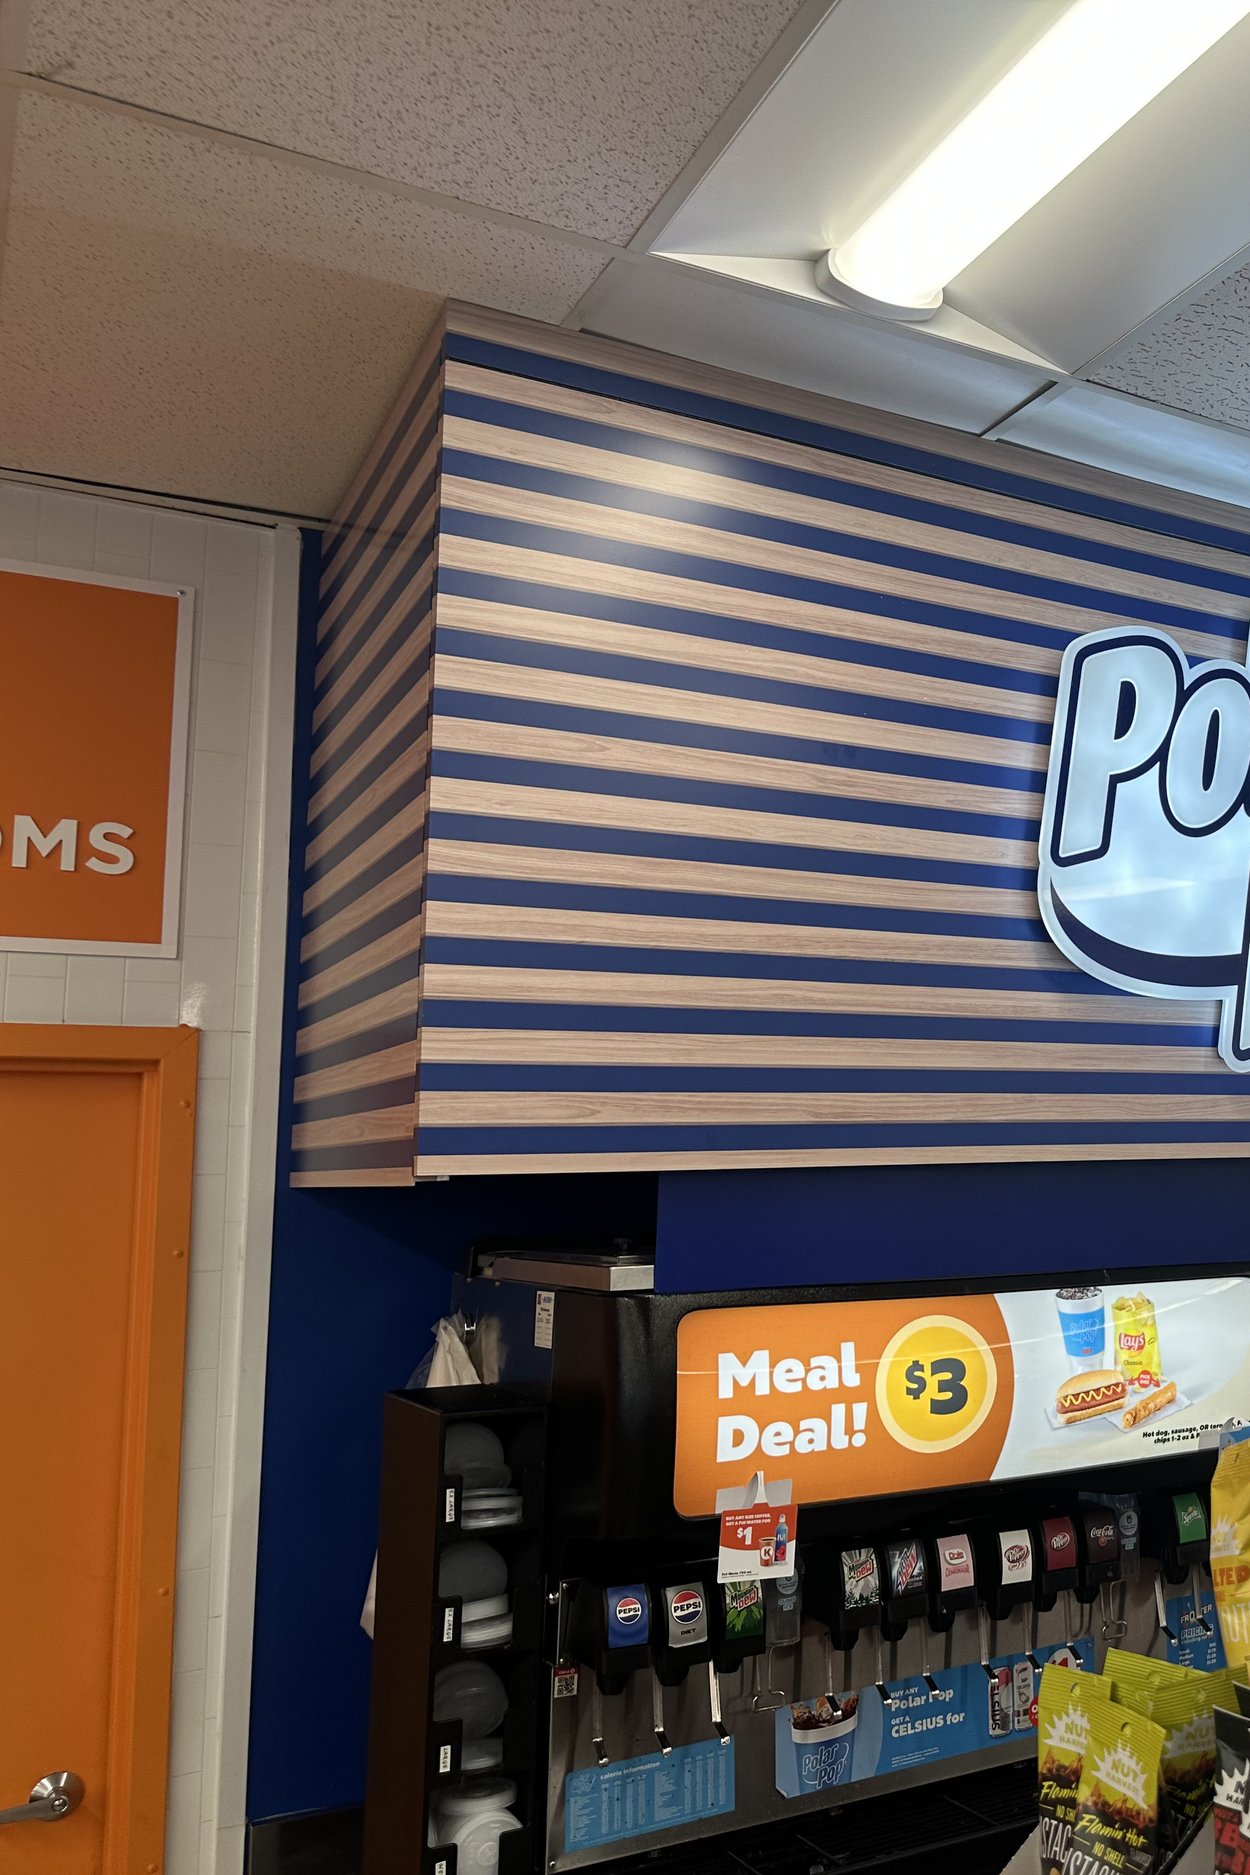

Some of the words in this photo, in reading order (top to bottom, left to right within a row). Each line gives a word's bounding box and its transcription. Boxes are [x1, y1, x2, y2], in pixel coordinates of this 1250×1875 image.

[0, 814, 134, 875] MS
[718, 1341, 861, 1399] Meal
[905, 1357, 969, 1415] $3
[716, 1402, 868, 1463] Deal!
[1171, 1426, 1198, 1435] sausage,
[1181, 1509, 1201, 1524] Sprite
[737, 1526, 752, 1545] $1
[763, 1549, 771, 1557] K
[948, 1552, 964, 1560] Dole
[618, 1606, 640, 1615] PEPSI
[673, 1602, 701, 1613] PEPSI
[905, 1687, 919, 1695] ANY
[891, 1696, 926, 1711] Polar
[891, 1717, 944, 1738] CELSIUS
[946, 1712, 965, 1724] for
[802, 1742, 840, 1775] Polar
[600, 1769, 623, 1780] calorie
[623, 1761, 661, 1775] information
[816, 1763, 846, 1790] Pop
[1110, 1758, 1140, 1784] NUT
[1105, 1771, 1142, 1796] HARVEST
[1056, 1804, 1064, 1818] NO
[1092, 1842, 1102, 1857] NO
[1103, 1846, 1126, 1869] SHELL
